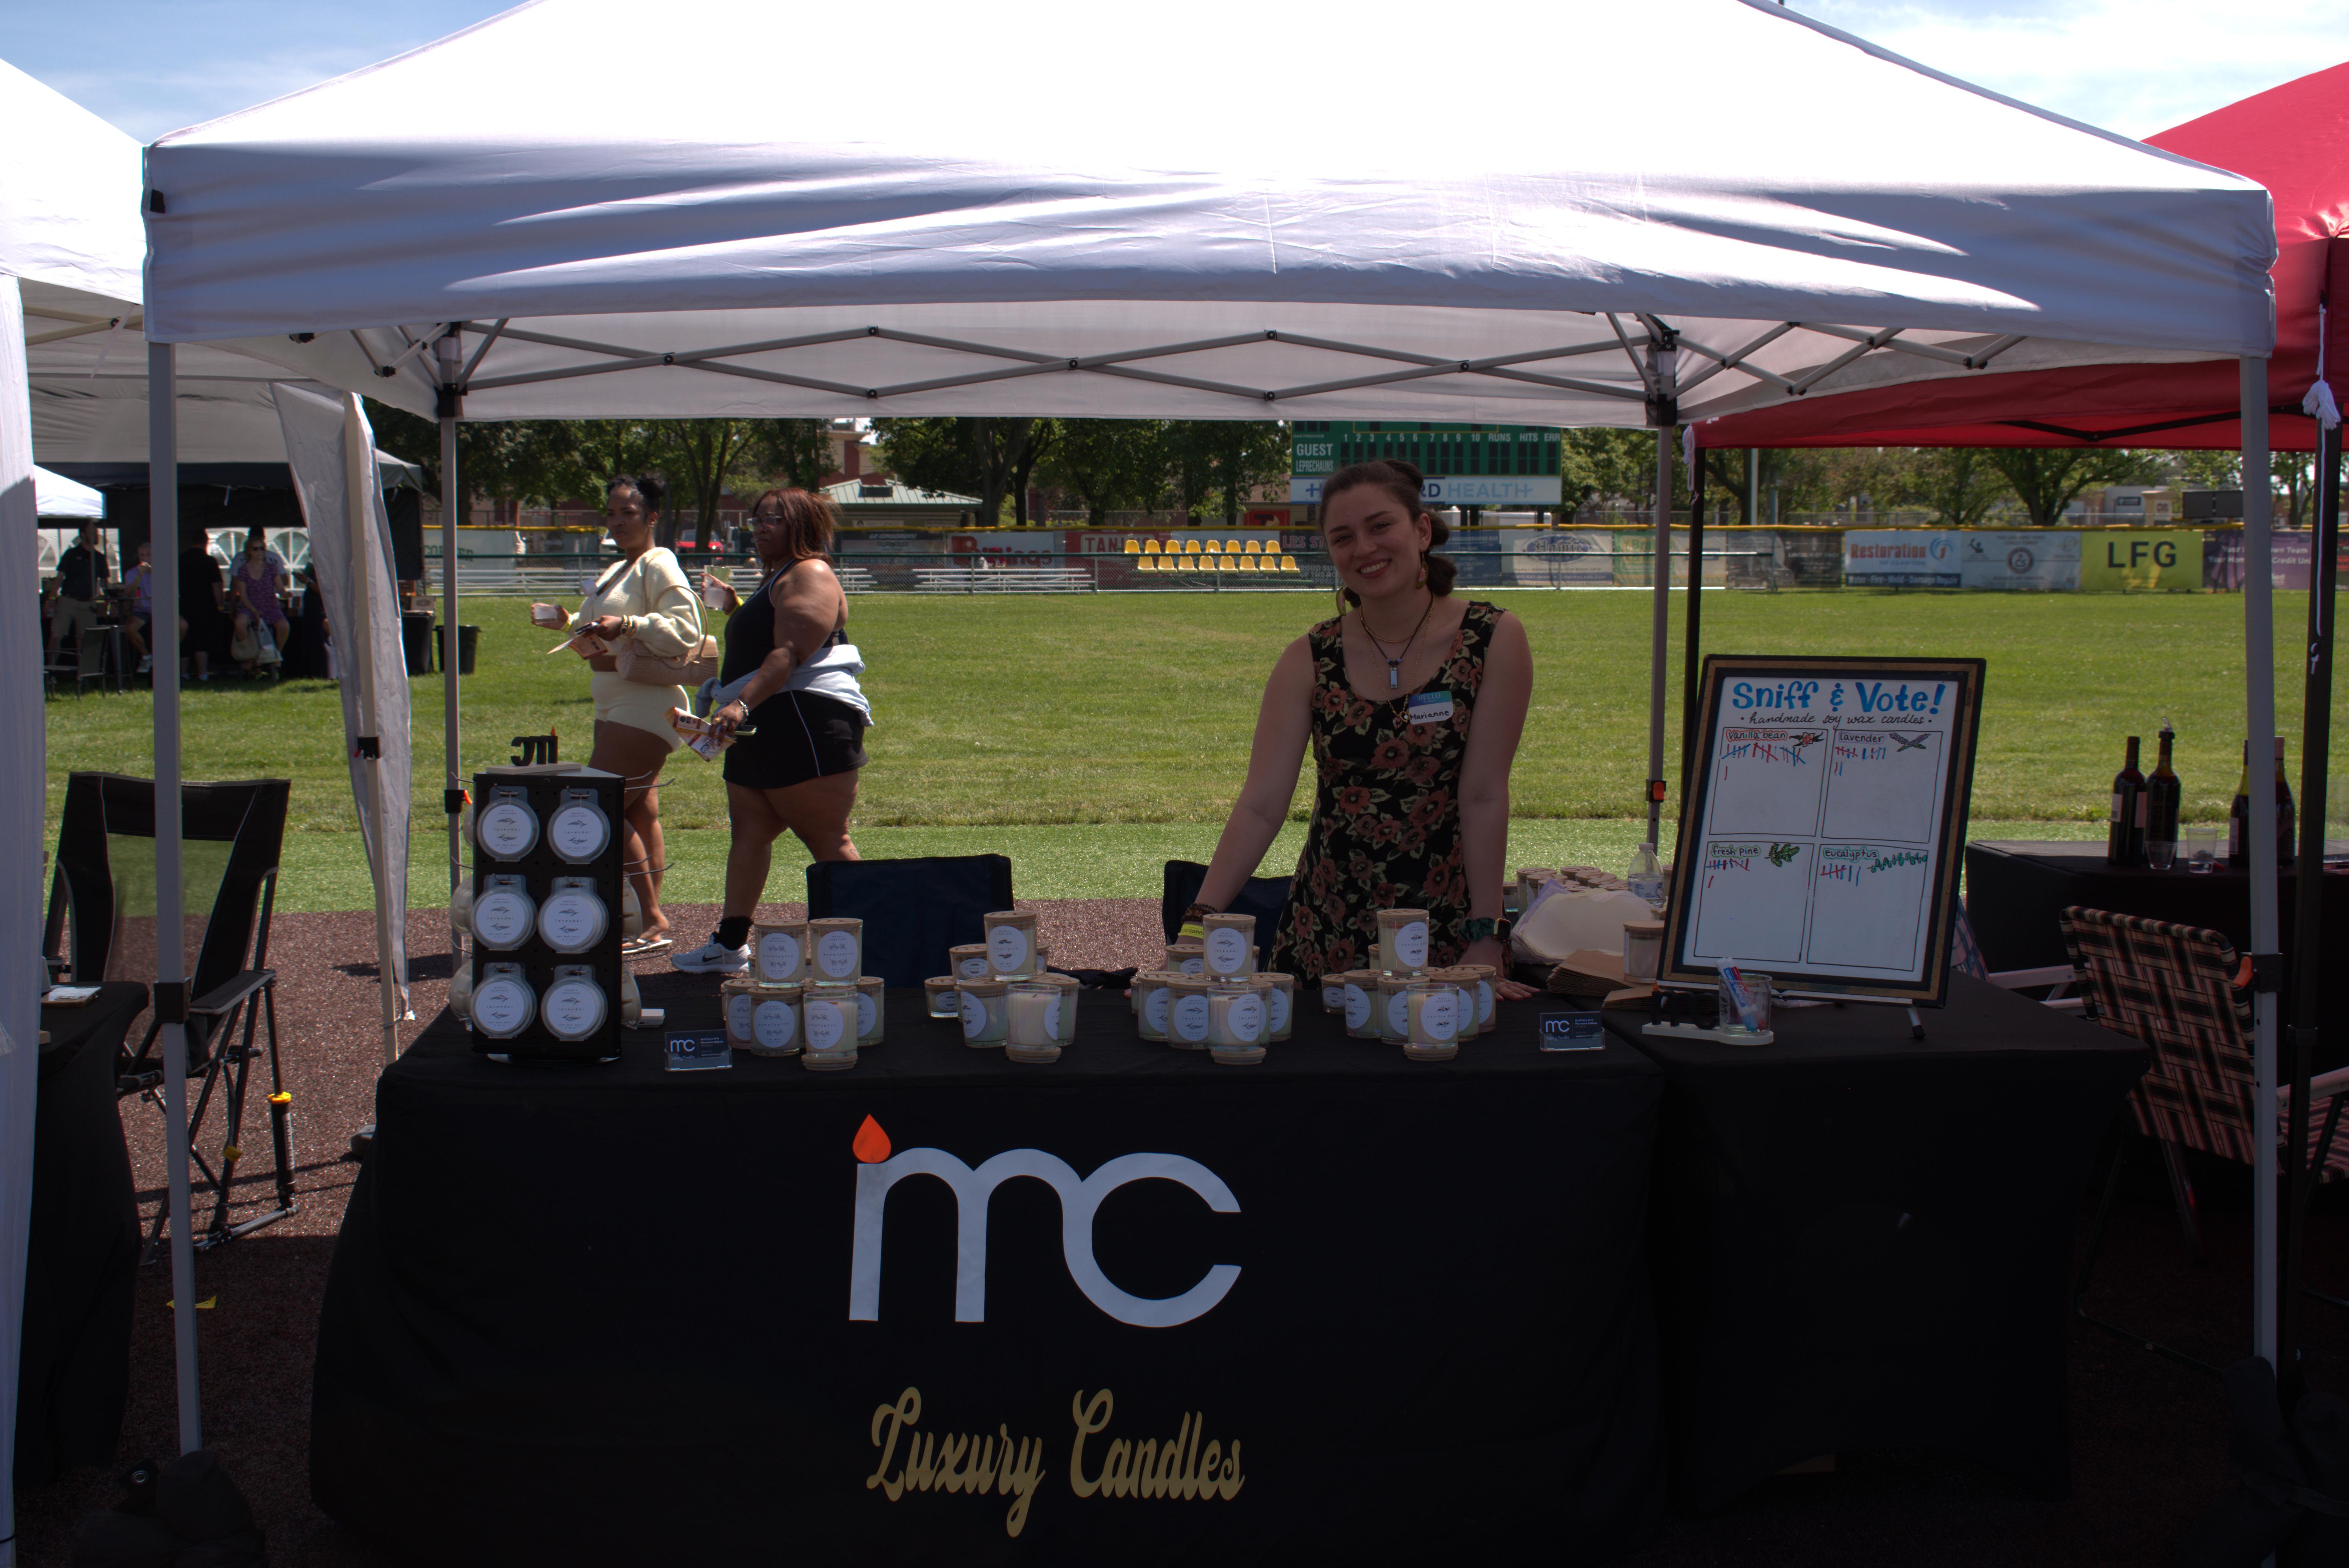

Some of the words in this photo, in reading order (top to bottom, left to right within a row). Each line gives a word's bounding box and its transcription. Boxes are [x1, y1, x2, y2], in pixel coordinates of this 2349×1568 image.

[1344, 433, 1348, 442] 1
[1356, 433, 1361, 442] 2
[1369, 433, 1374, 442] 3
[1386, 433, 1391, 442] 4
[1399, 433, 1404, 442] 5
[1413, 433, 1418, 442] 6
[1430, 433, 1435, 442] 7
[1443, 433, 1447, 442] 8
[1456, 433, 1461, 442] 9
[1472, 433, 1480, 442] 10
[1488, 433, 1511, 442] RUNS
[1520, 433, 1538, 442] HITS
[1544, 433, 1560, 442] ERR
[1296, 444, 1333, 456] GUEST
[1296, 460, 1333, 472] LEPRECHAUNS
[1448, 483, 1533, 498] HEALTH
[1282, 535, 1306, 549] LES
[1850, 543, 1926, 559] Restoration
[2108, 541, 2176, 568] LFG
[1418, 692, 1441, 701] HELLO
[1732, 681, 1819, 710] Sniff
[1855, 682, 1946, 715] Vote!
[1410, 710, 1450, 721] Marianne
[1749, 712, 1816, 724] handmade
[1822, 715, 1842, 729] soy
[1847, 715, 1876, 723] wax
[1881, 713, 1925, 724] candles
[1728, 731, 1760, 739] vanilla
[1763, 731, 1787, 739] bean
[1839, 732, 1884, 743] lavender
[1713, 846, 1736, 856] fresh
[1739, 847, 1759, 856] pine
[1825, 849, 1877, 861] eucalyptus
[1545, 1020, 1570, 1032] mc
[670, 1039, 695, 1052] mc
[849, 1147, 1242, 1327] mc
[866, 1386, 1046, 1538] Luxury
[1069, 1388, 1246, 1501] Candles
